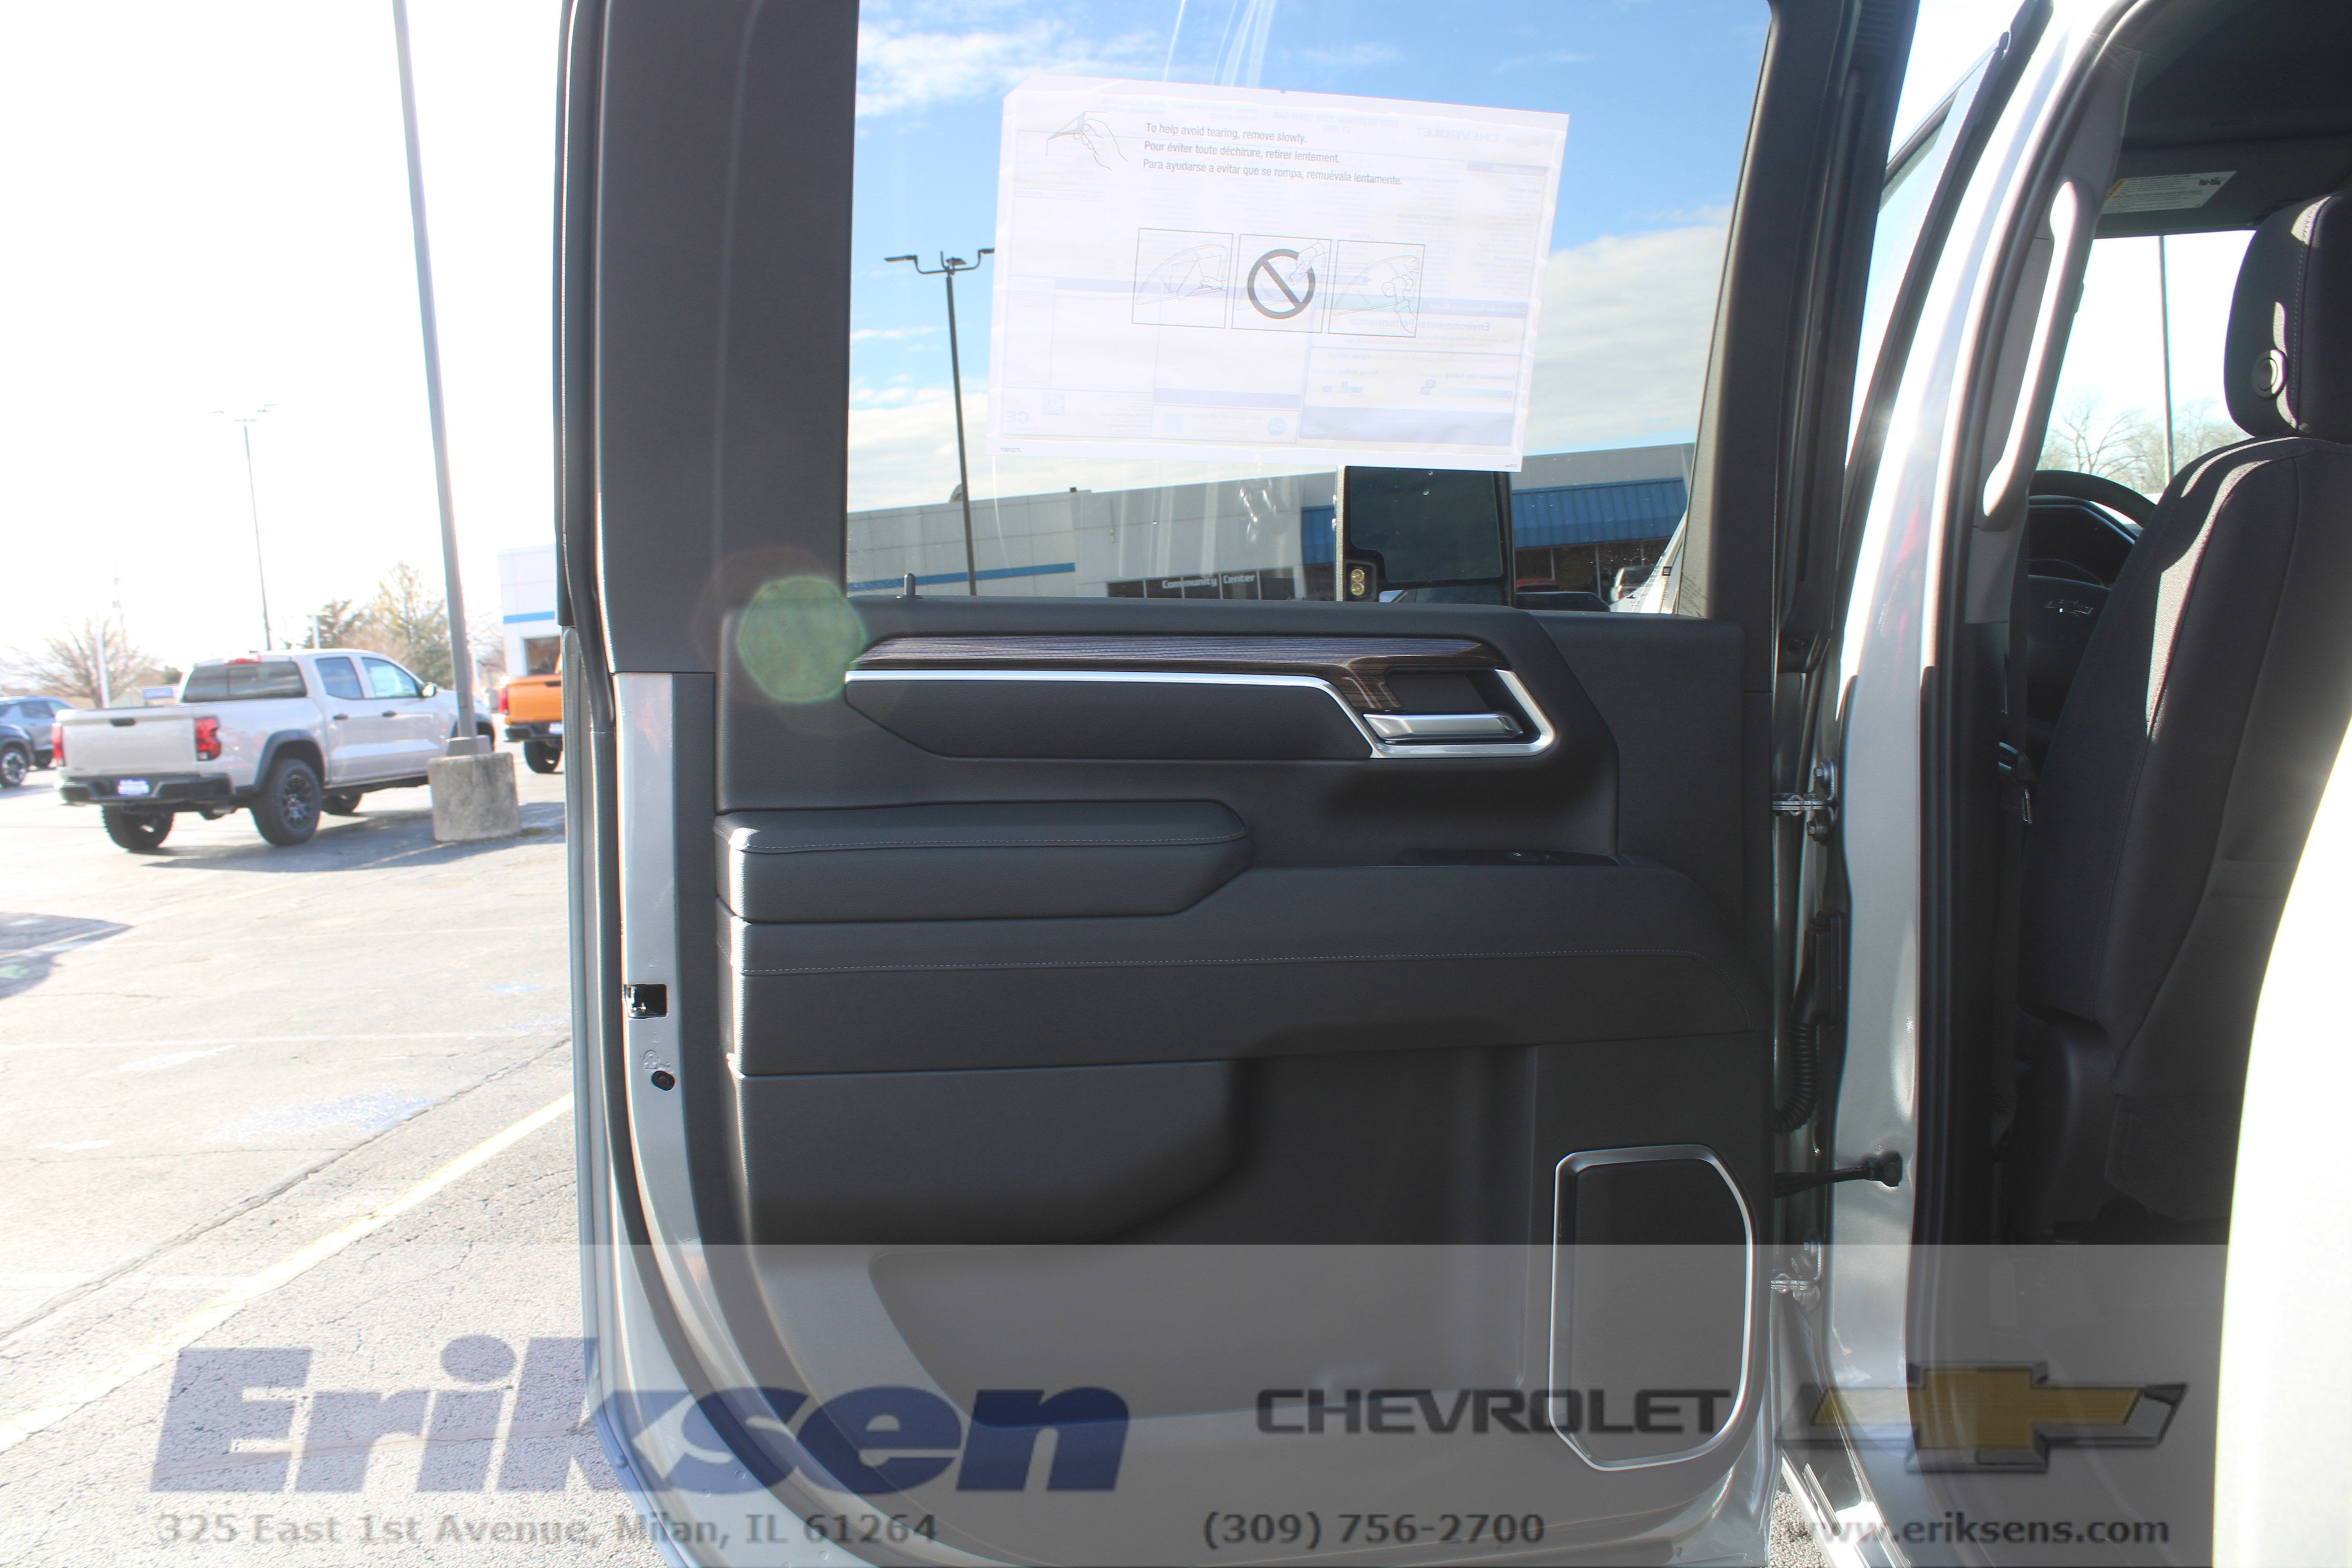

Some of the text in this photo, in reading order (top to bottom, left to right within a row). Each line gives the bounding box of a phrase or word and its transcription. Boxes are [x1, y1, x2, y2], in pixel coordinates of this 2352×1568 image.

[1146, 123, 1307, 145] To help avoid tearing, remove slowly.
[1144, 141, 1340, 163] Pour éviter toute déchirure, retirer lentement.
[1143, 158, 1163, 169] Para
[1166, 162, 1206, 172] ayudarse
[1217, 164, 1241, 174] evitar
[1243, 167, 1258, 176] que
[1274, 169, 1304, 180] rompa,
[1307, 170, 1351, 181] remuévala
[1354, 173, 1403, 185] lentamente.
[1162, 575, 1255, 589] Community Center
